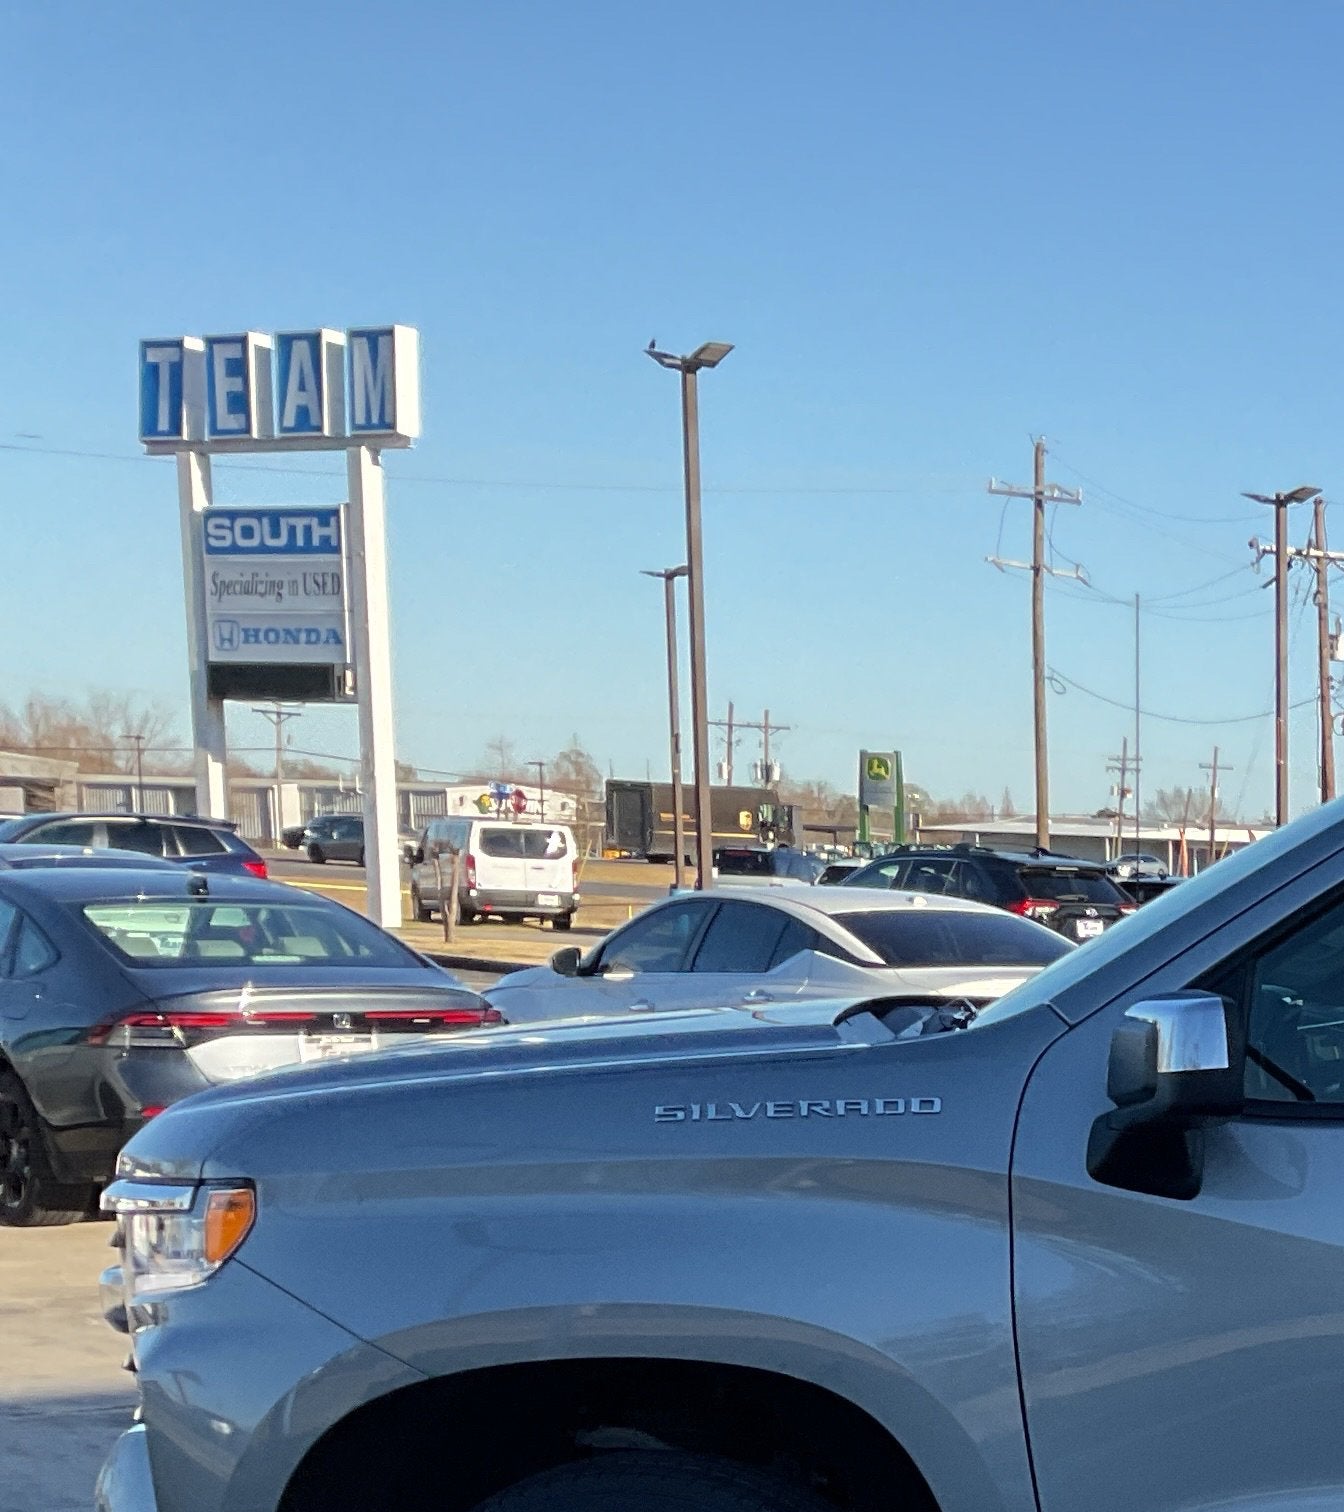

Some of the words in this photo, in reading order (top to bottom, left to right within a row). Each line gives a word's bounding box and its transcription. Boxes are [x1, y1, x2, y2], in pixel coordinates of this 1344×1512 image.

[145, 335, 393, 431] TEAM
[207, 516, 338, 547] SOUTH
[210, 570, 284, 602] Specializing
[287, 572, 299, 596] in
[302, 571, 341, 597] USED
[241, 626, 343, 645] HONDA
[655, 1097, 943, 1122] SILVERADO
